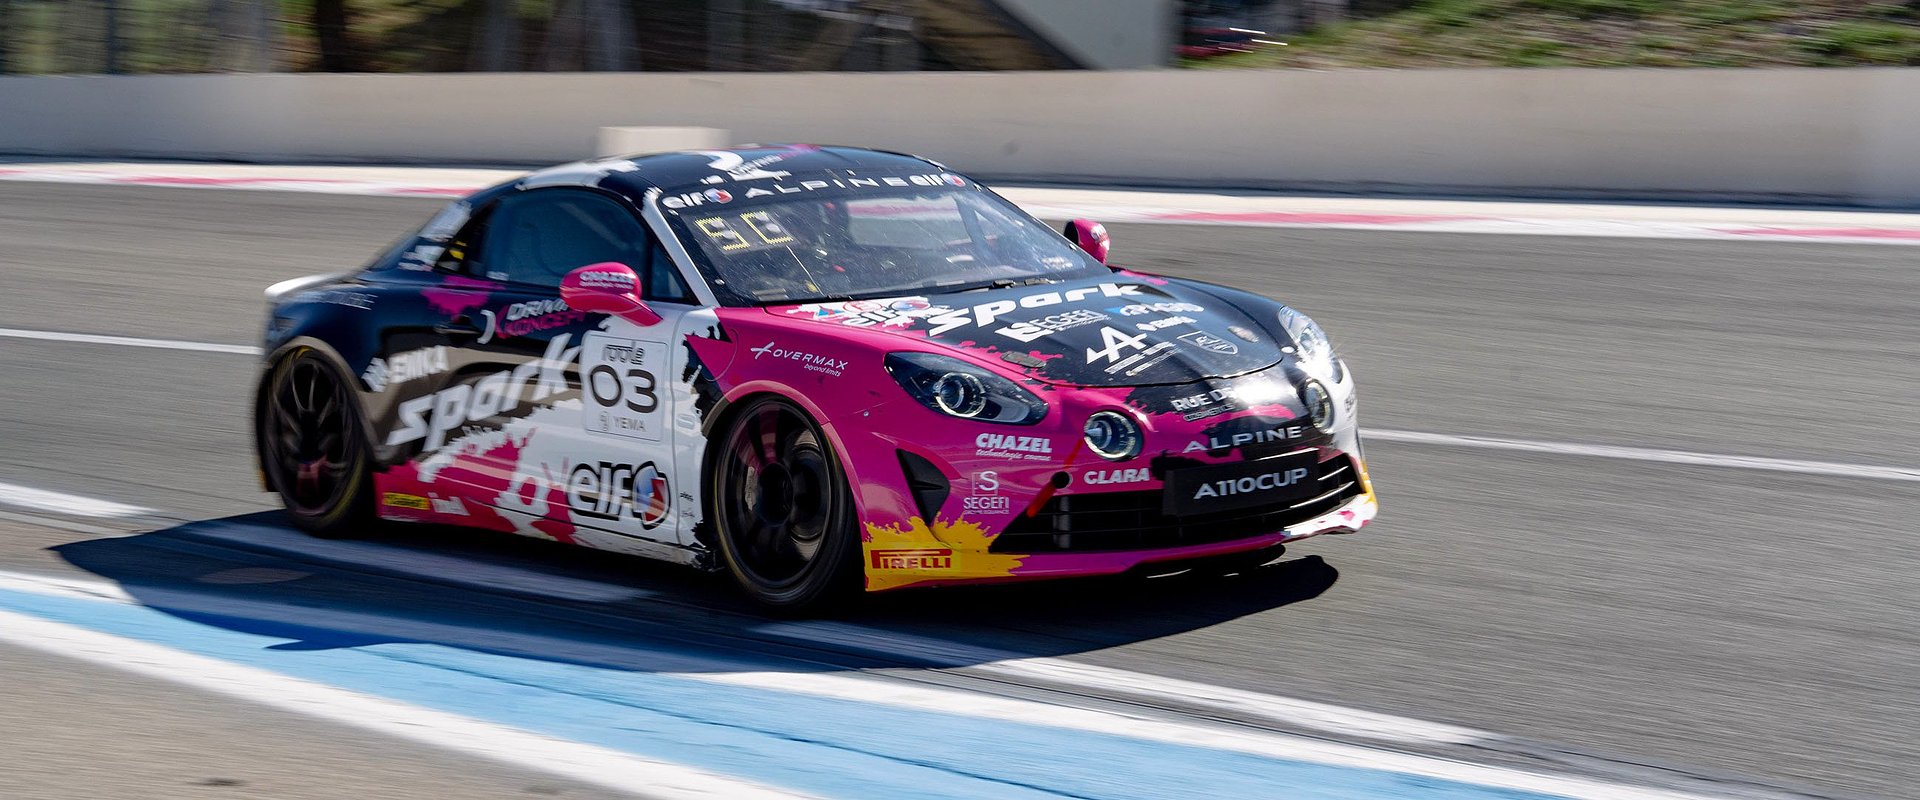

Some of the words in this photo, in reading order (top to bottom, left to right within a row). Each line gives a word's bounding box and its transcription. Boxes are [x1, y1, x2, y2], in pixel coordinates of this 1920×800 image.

[744, 176, 910, 199] ALPINE
[773, 349, 848, 370] OVERMAX
[825, 367, 841, 377] limits
[590, 364, 658, 413] 03
[1170, 393, 1214, 412] RUE
[614, 416, 646, 432] YEMA
[976, 433, 1052, 453] CHAZEL
[1182, 426, 1302, 454] ALPINE
[1084, 468, 1149, 484] CLARA
[1193, 467, 1308, 499] A110CUP
[567, 461, 633, 521] elf
[963, 496, 1010, 509] SEGEFI
[871, 549, 952, 569] PIRELLI
